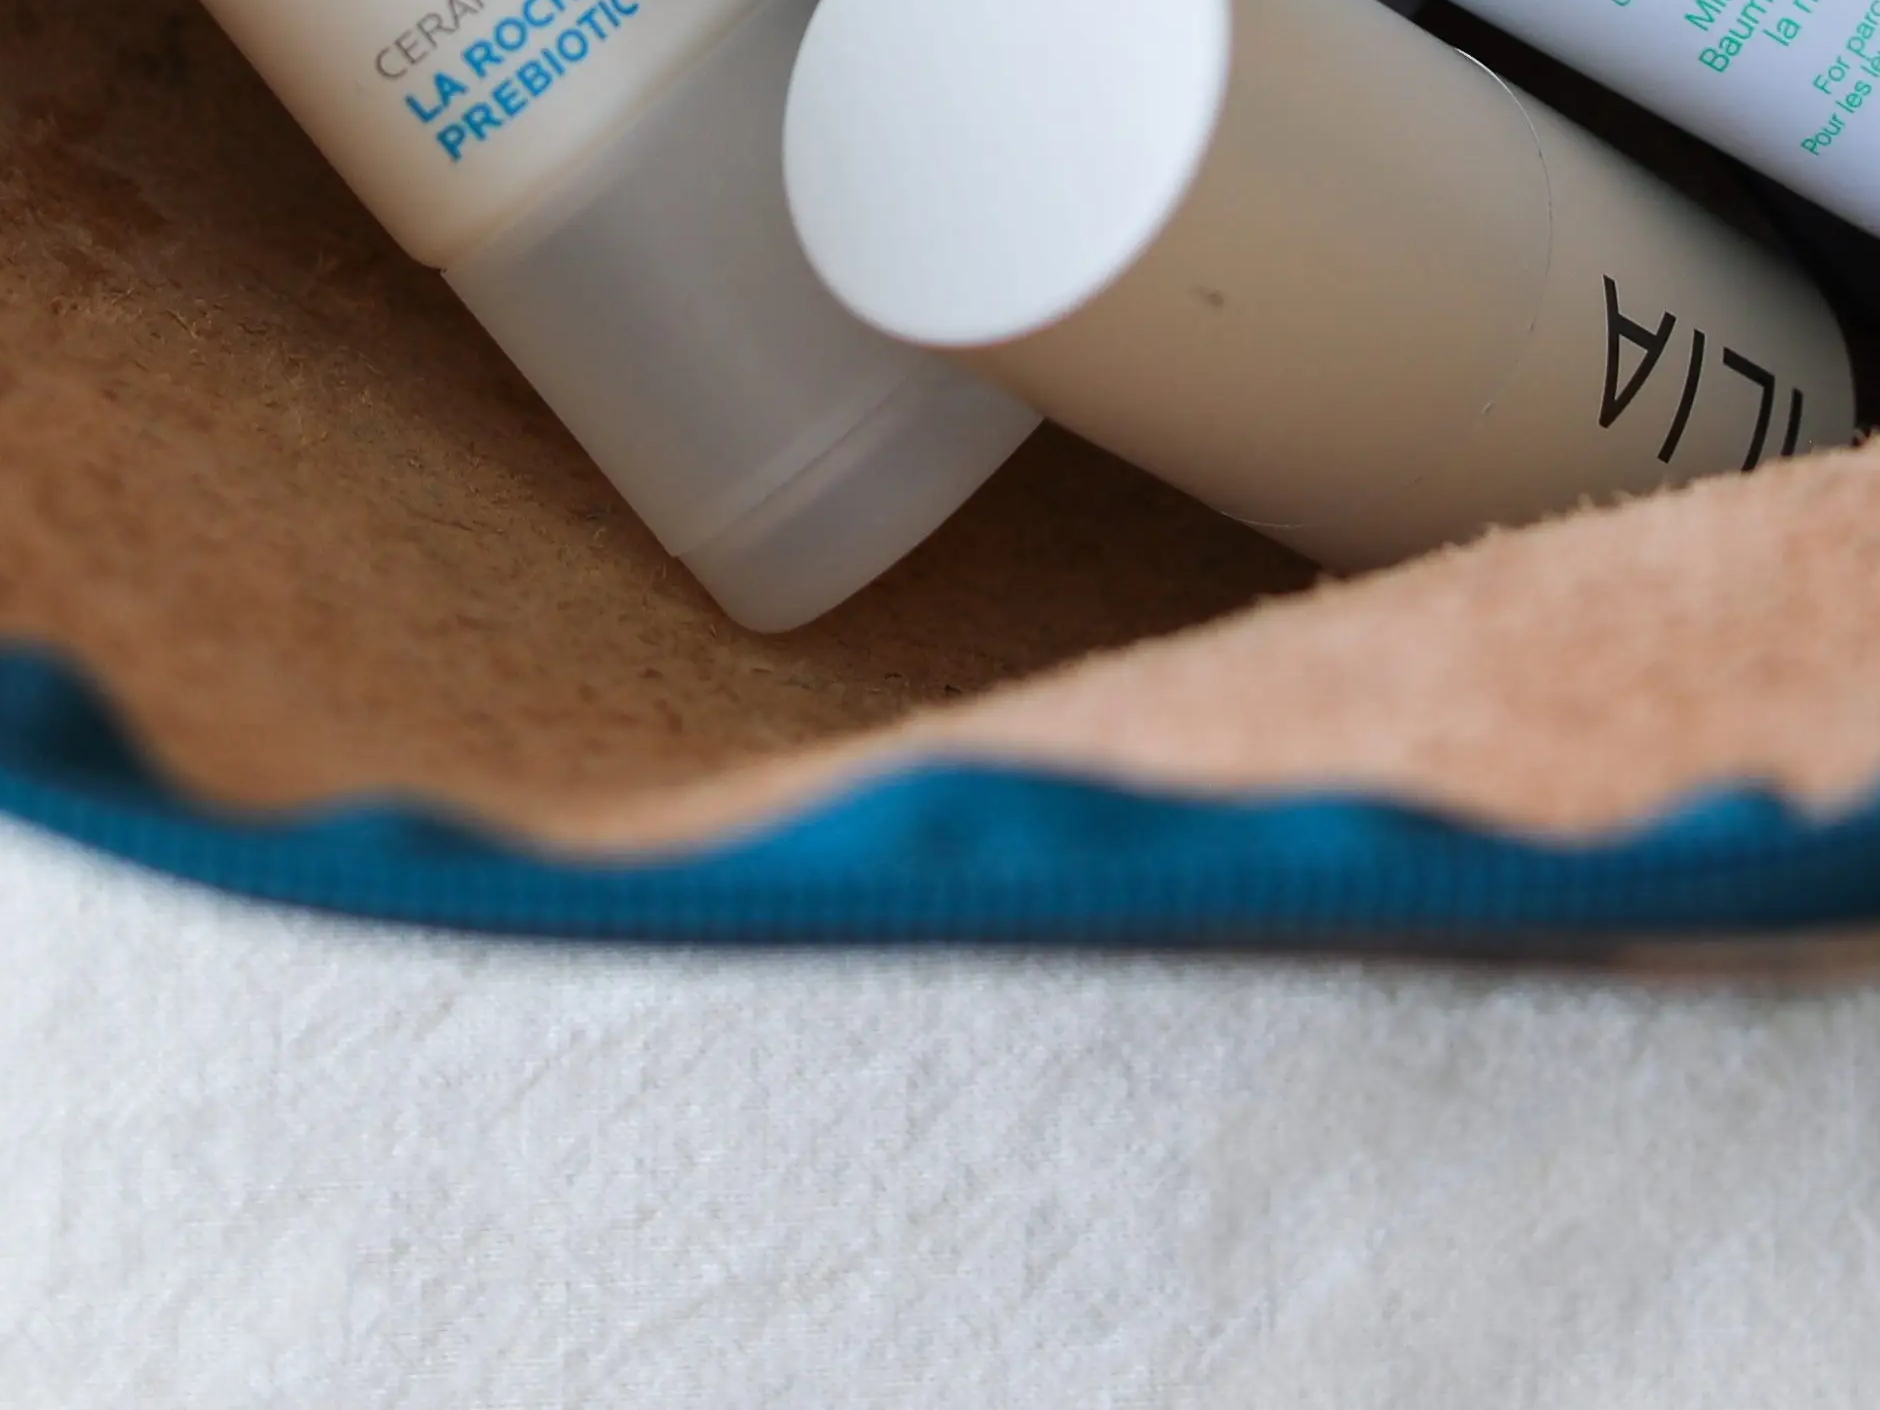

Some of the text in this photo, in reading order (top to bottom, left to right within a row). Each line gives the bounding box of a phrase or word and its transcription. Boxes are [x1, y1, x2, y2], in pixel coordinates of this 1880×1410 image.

[1762, 17, 1801, 46] la
[1813, 56, 1851, 94] For
[405, 73, 466, 123] LA
[1801, 114, 1844, 155] Pour
[1836, 81, 1872, 113] les
